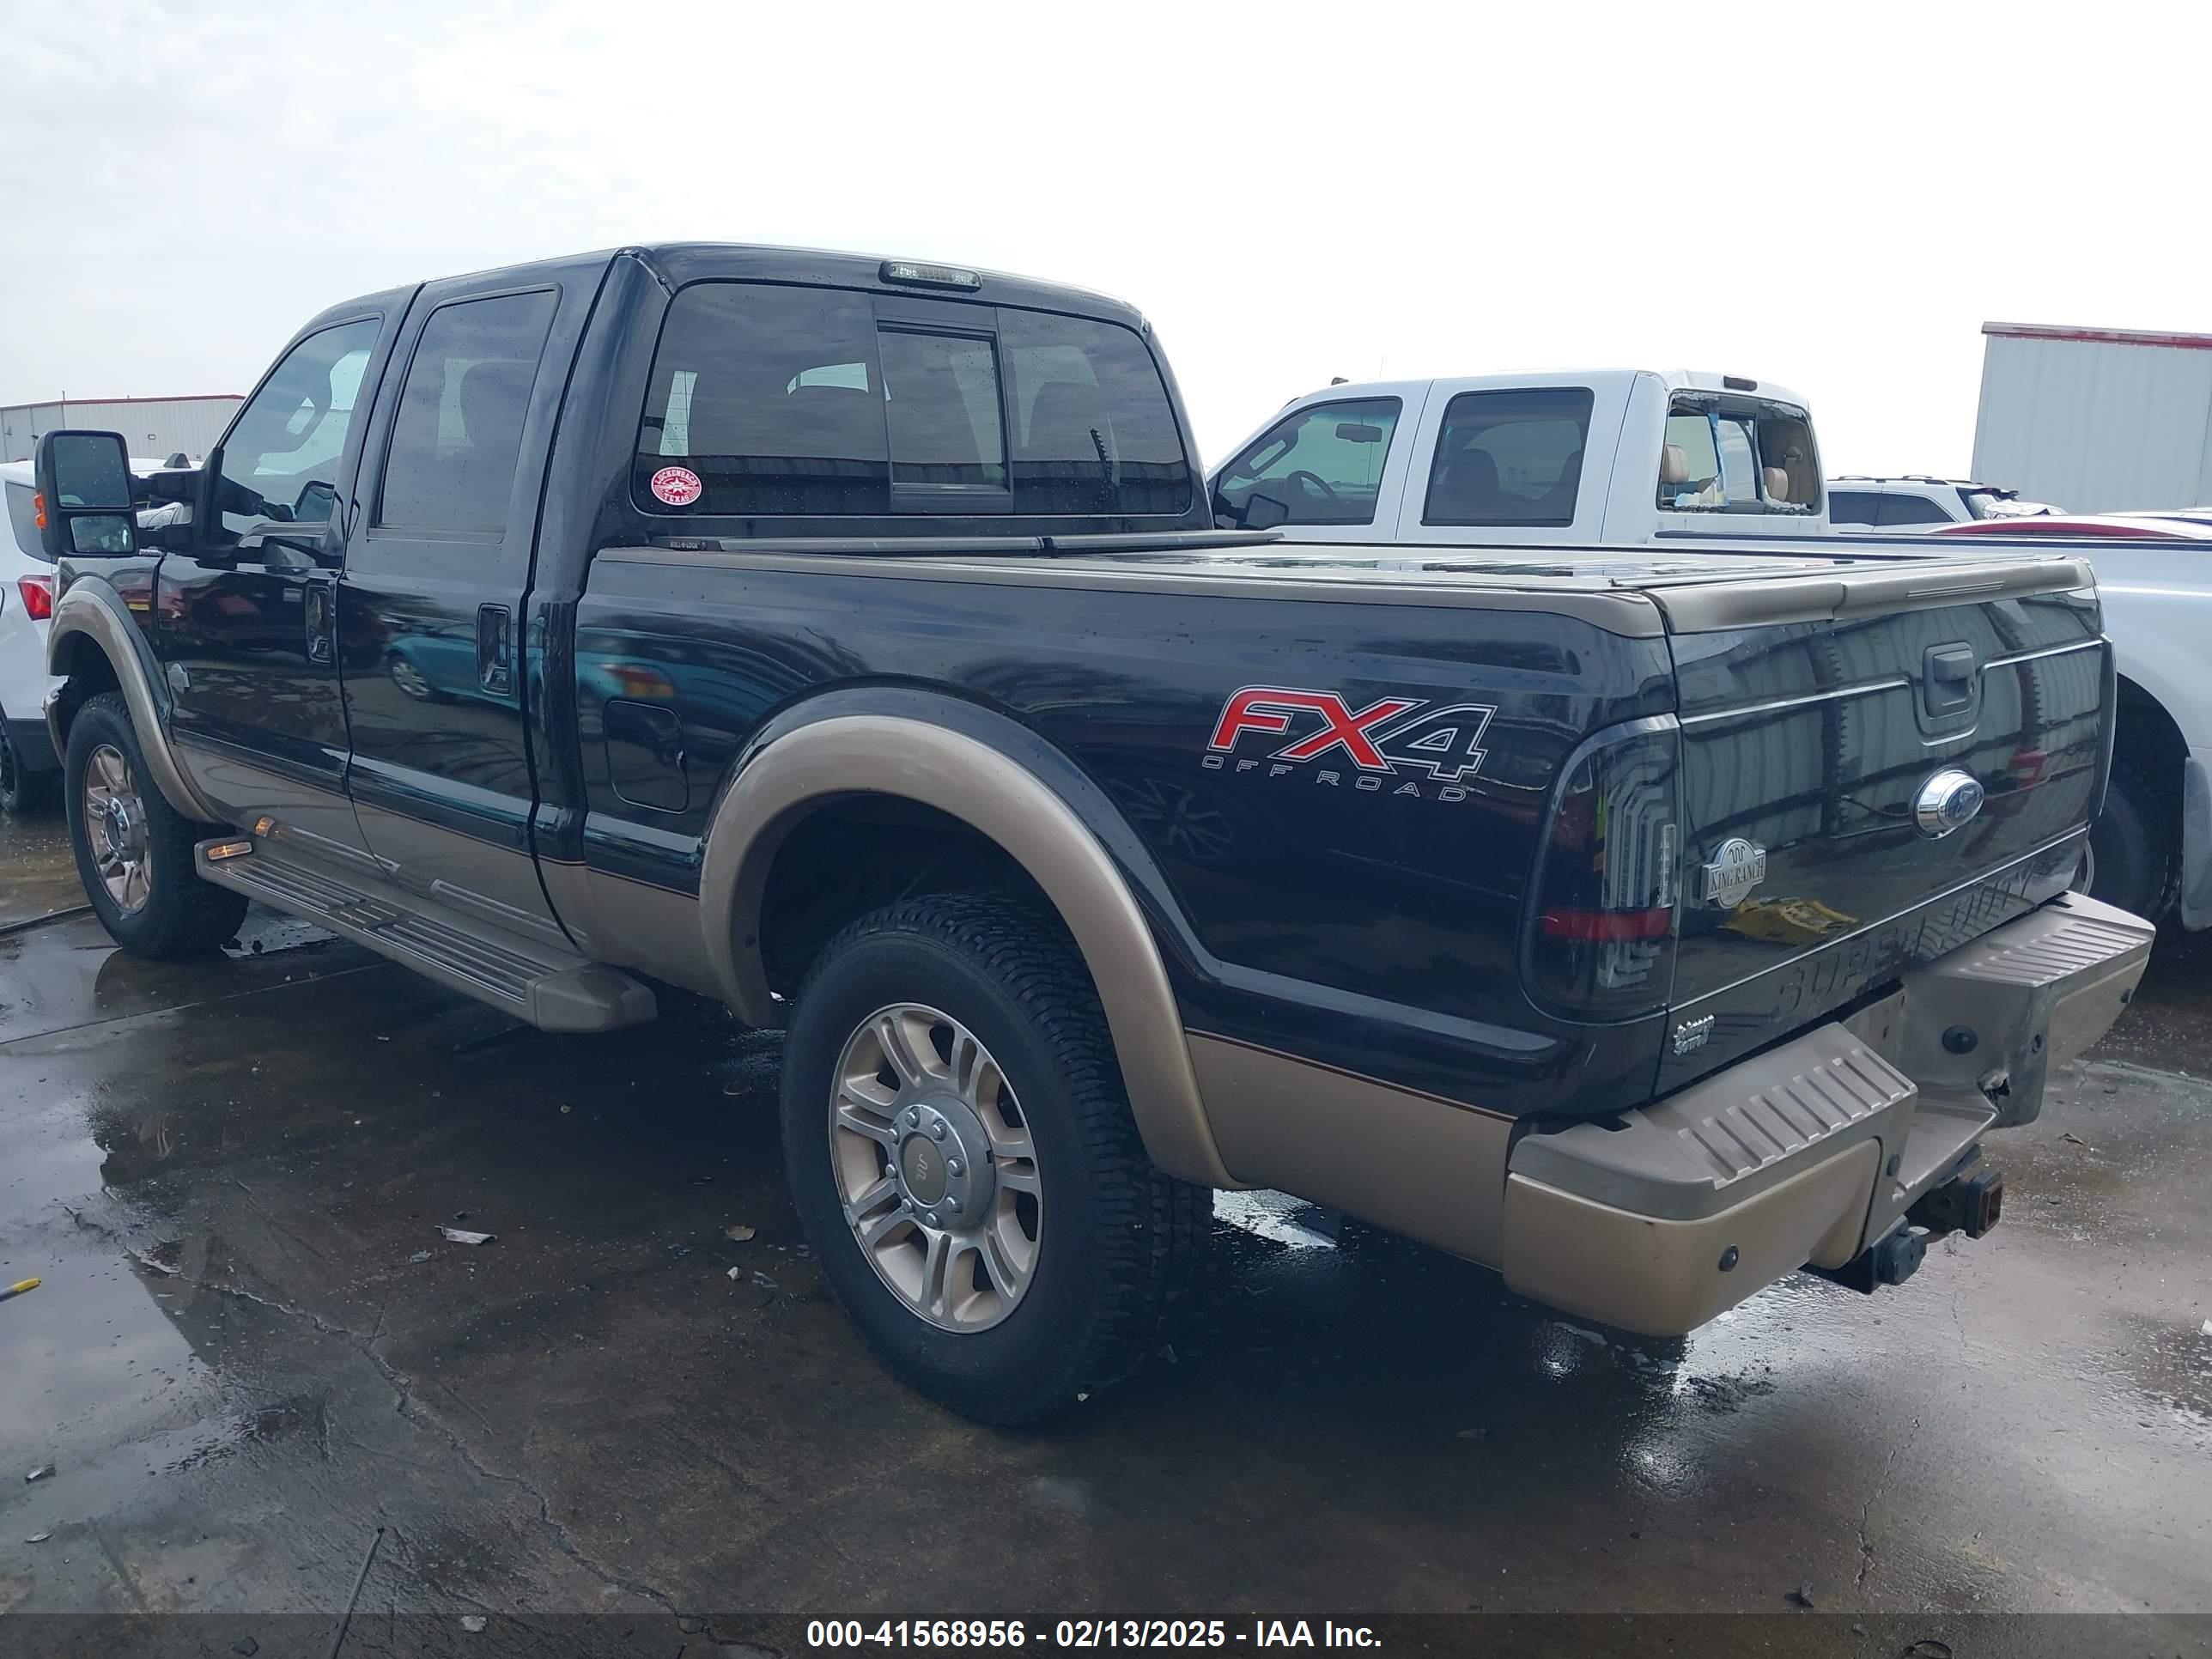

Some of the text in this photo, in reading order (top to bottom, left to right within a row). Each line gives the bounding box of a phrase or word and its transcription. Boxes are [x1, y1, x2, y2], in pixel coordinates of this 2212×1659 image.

[653, 469, 699, 486] LUCKENBACH
[664, 492, 690, 503] TEXAS
[1206, 684, 1498, 783] FX4
[1202, 754, 1467, 802] OFF ROAD
[1711, 857, 1764, 892] KING RANCH
